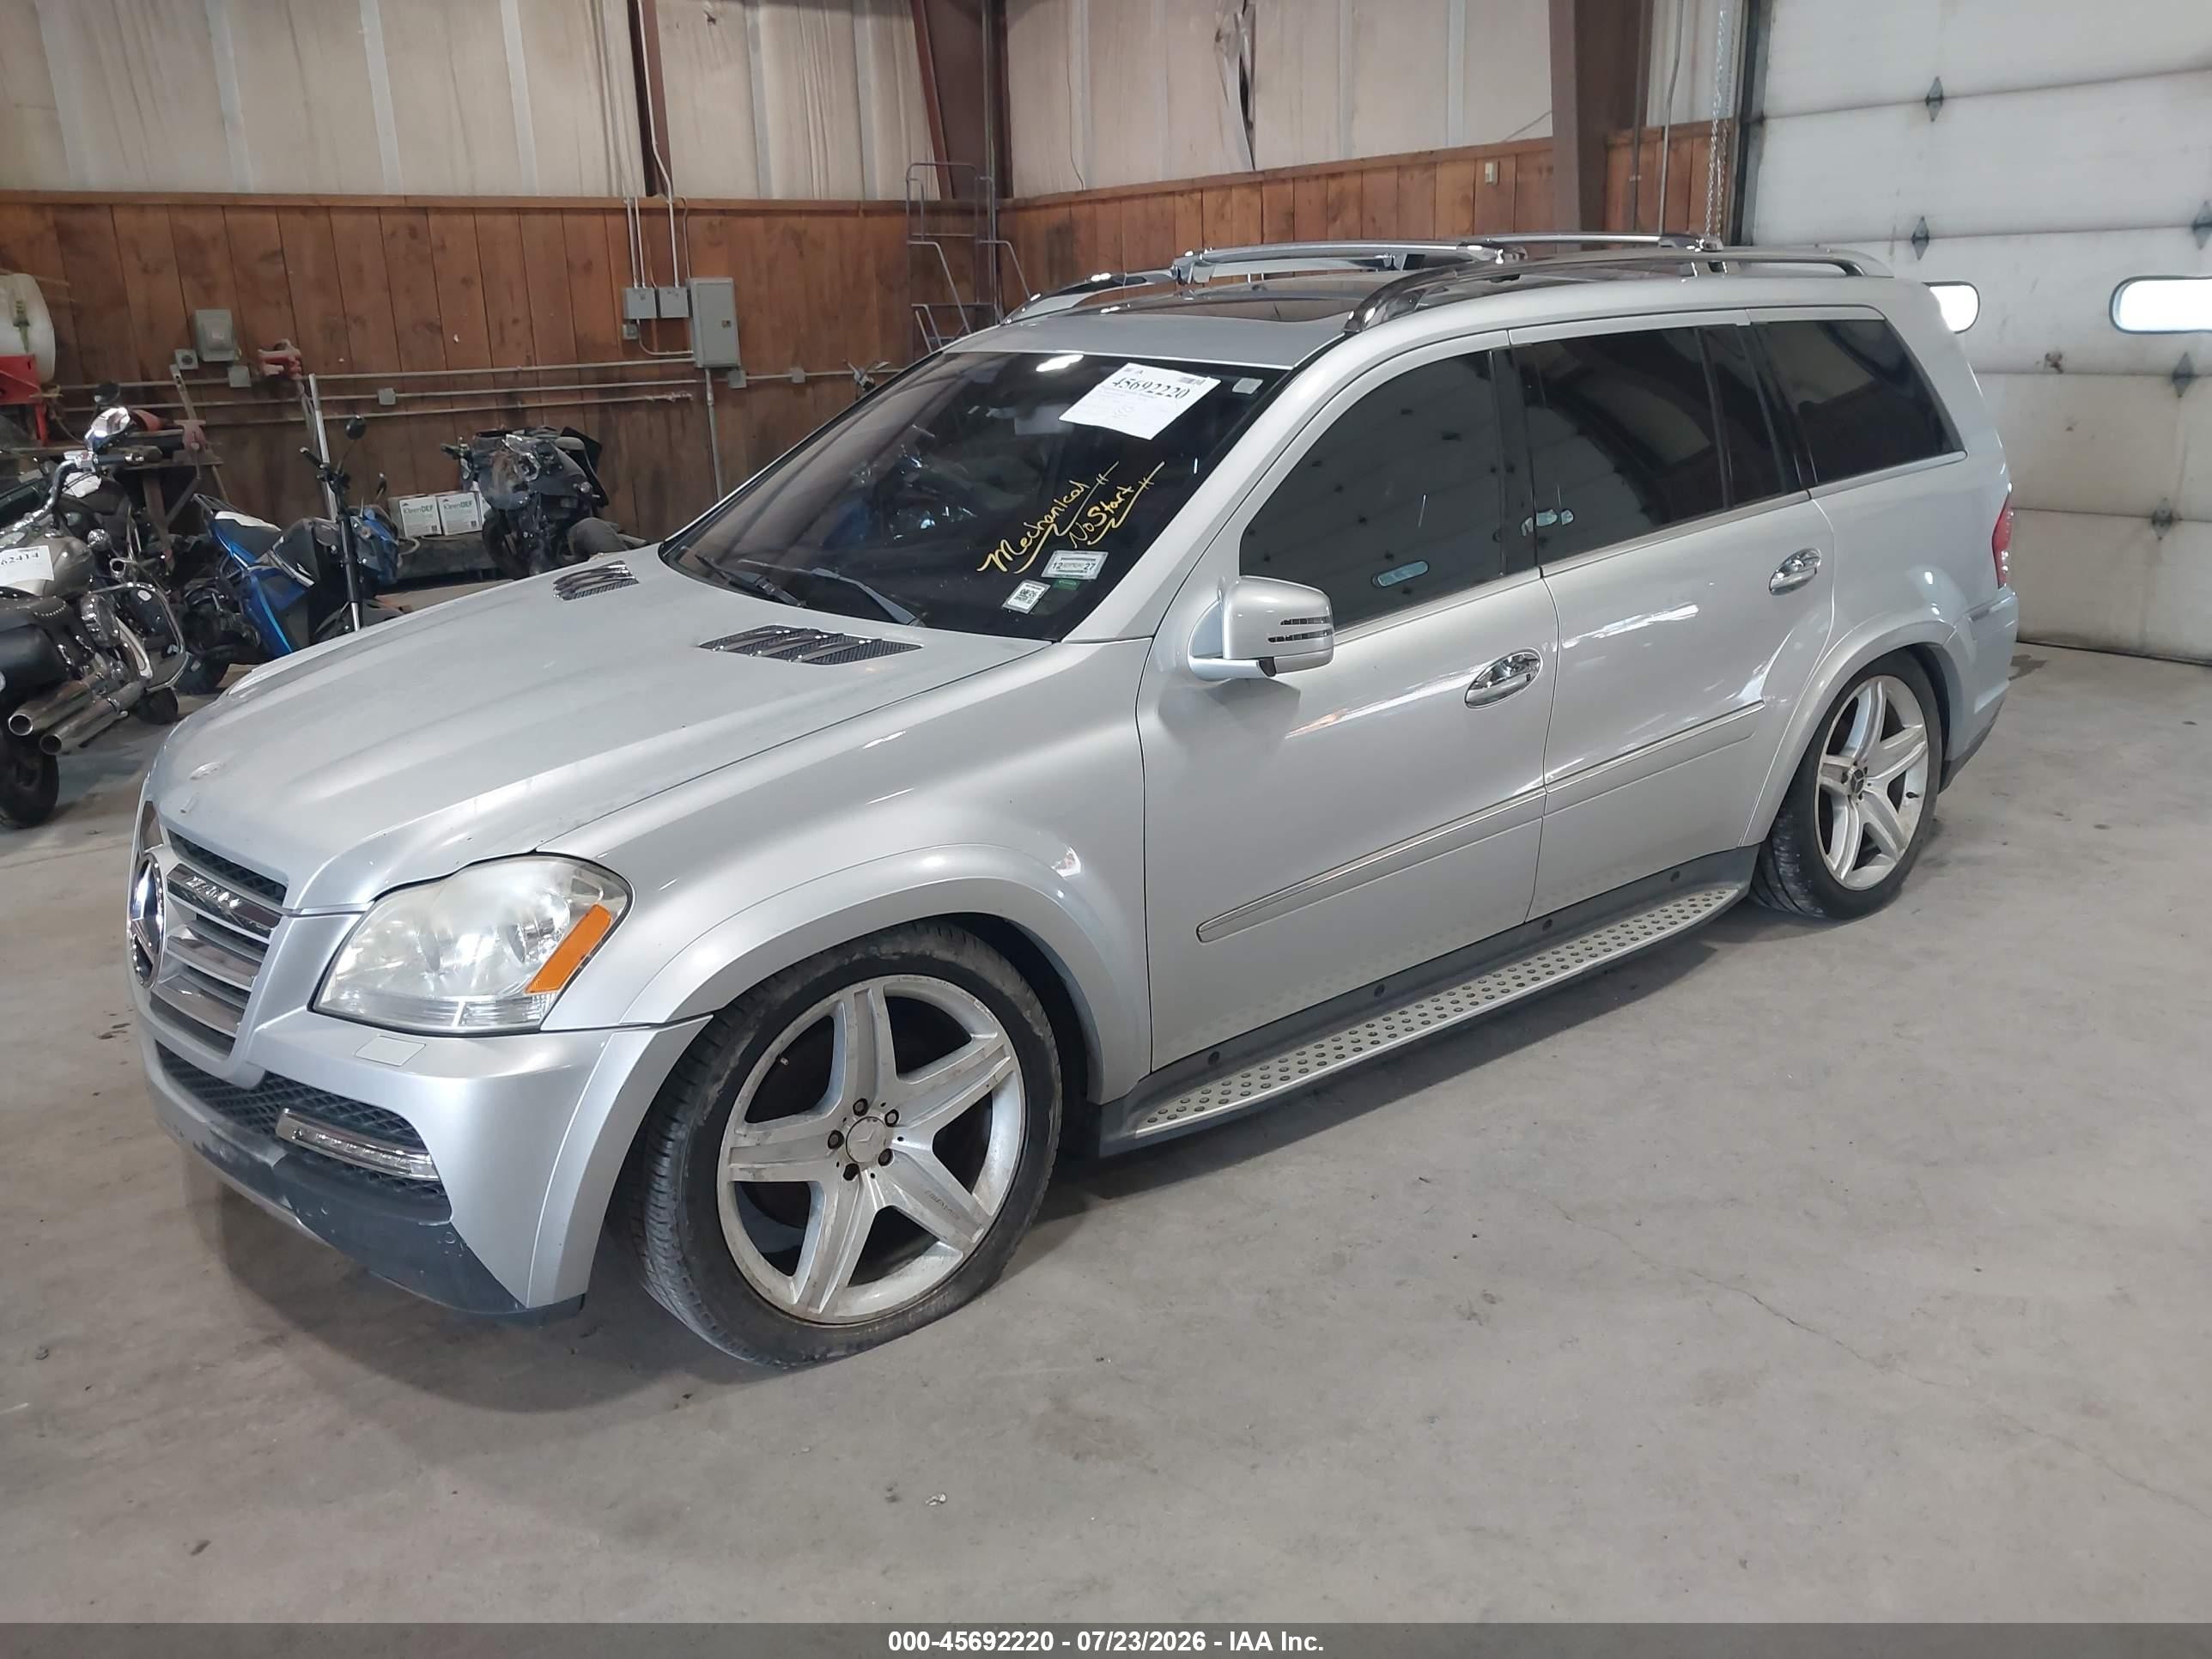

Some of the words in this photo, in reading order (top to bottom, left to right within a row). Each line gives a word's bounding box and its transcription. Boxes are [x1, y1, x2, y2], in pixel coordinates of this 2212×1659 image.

[1112, 378, 1191, 399] 45692220
[976, 478, 1091, 573] Mechanical
[1069, 522, 1096, 549] No
[1087, 484, 1134, 528] Start
[1052, 562, 1063, 570] 12
